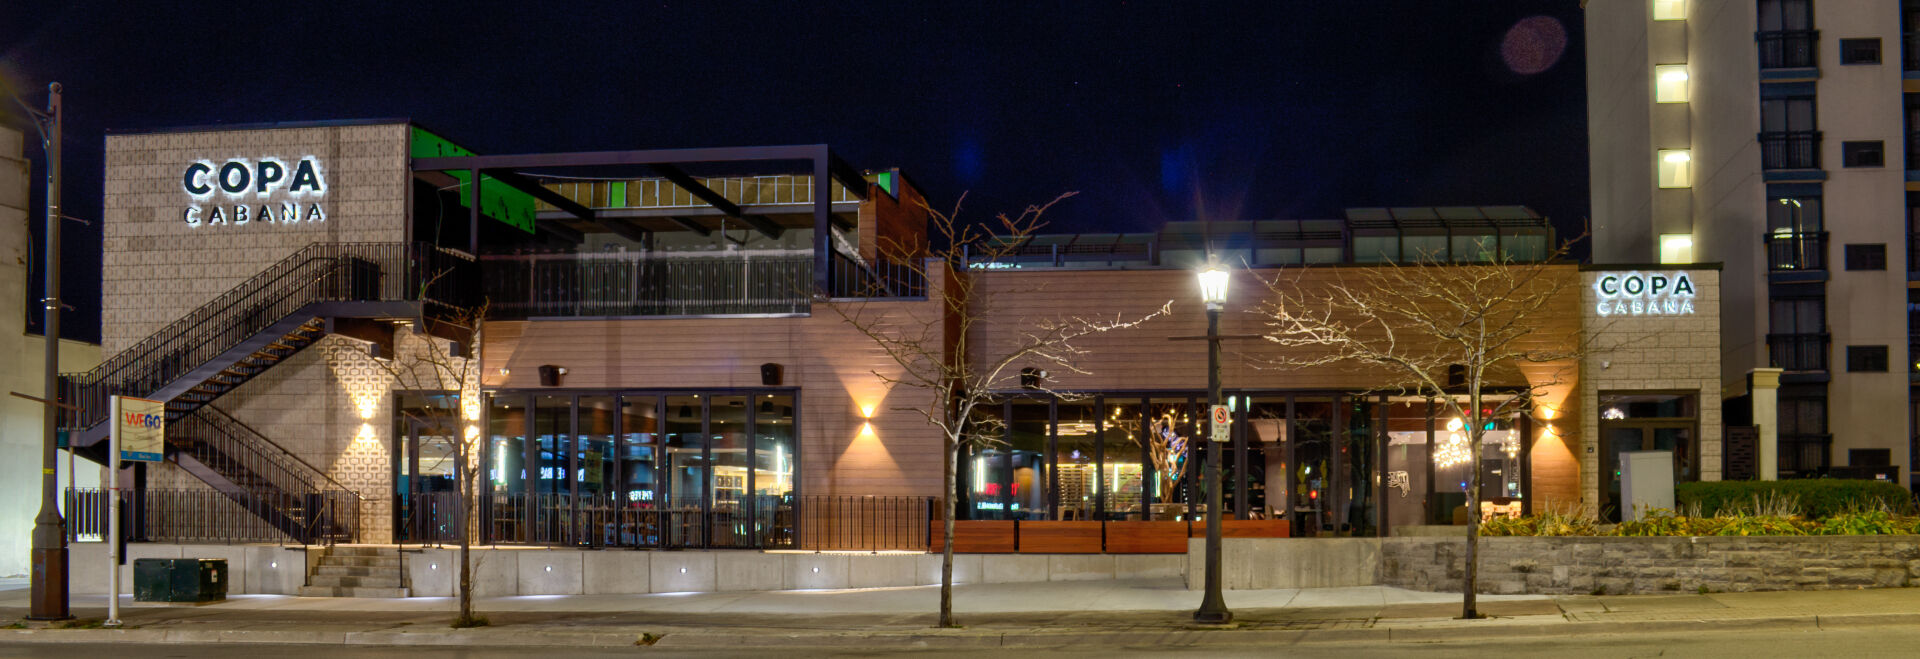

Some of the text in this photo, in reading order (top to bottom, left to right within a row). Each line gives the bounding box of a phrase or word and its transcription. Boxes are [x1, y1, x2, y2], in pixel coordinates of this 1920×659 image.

[183, 159, 322, 196] COPA
[183, 203, 322, 224] CABANA
[1599, 275, 1694, 295] COPA
[1597, 300, 1694, 315] CABANA
[125, 411, 161, 429] WEGO
